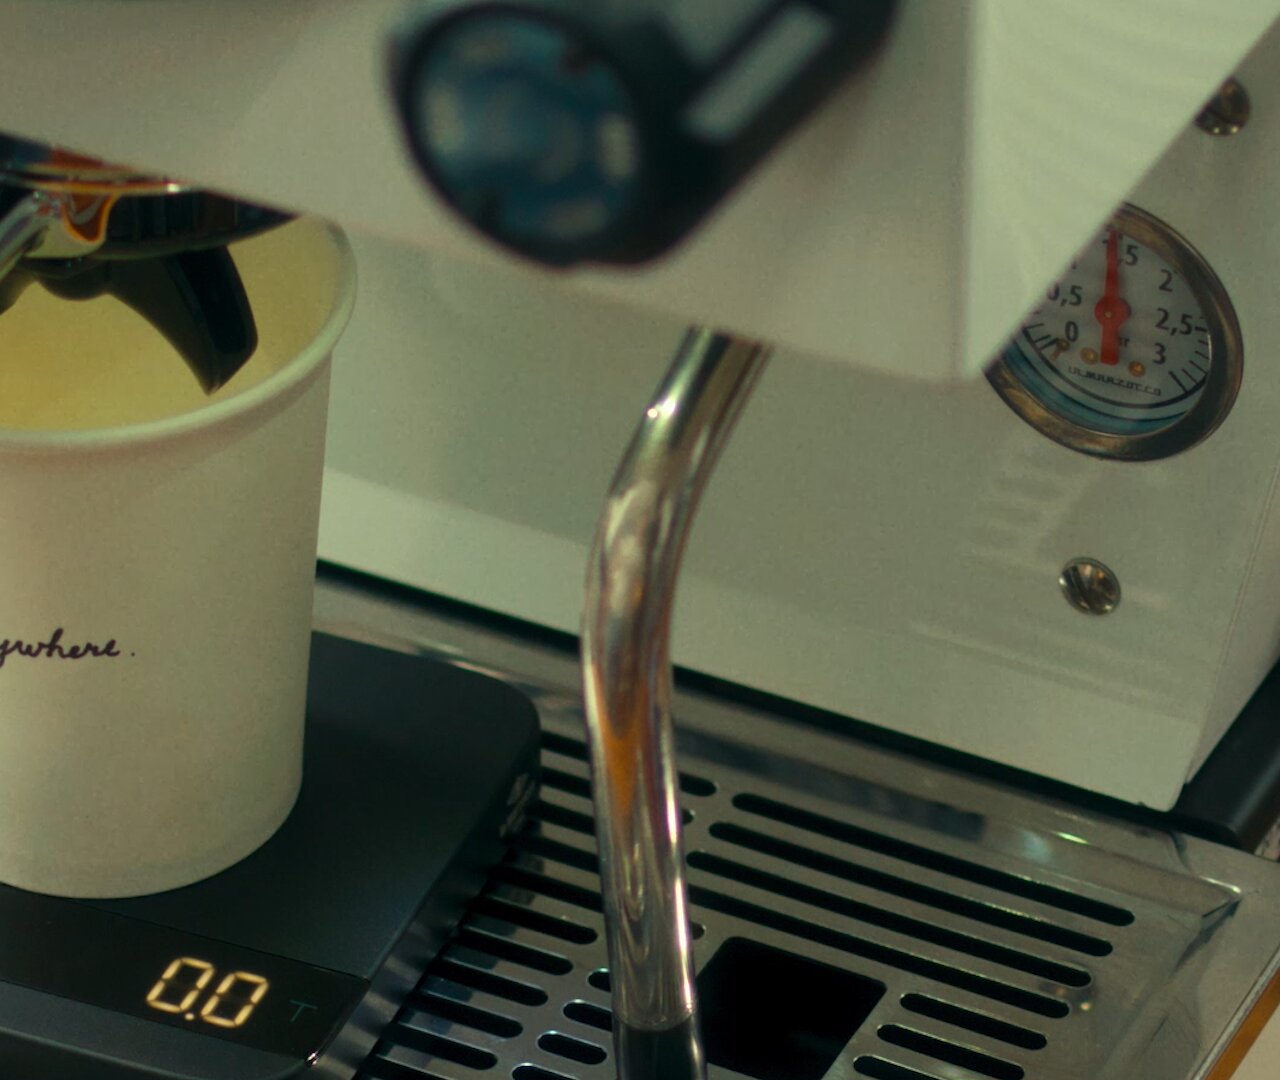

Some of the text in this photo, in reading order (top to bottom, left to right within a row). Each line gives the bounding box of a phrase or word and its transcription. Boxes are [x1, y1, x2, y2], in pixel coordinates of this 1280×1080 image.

[1158, 269, 1173, 292] 2
[1065, 321, 1079, 342] 0
[1155, 308, 1193, 336] 2,5
[1152, 342, 1166, 365] 3
[145, 957, 269, 1028] 0.0
